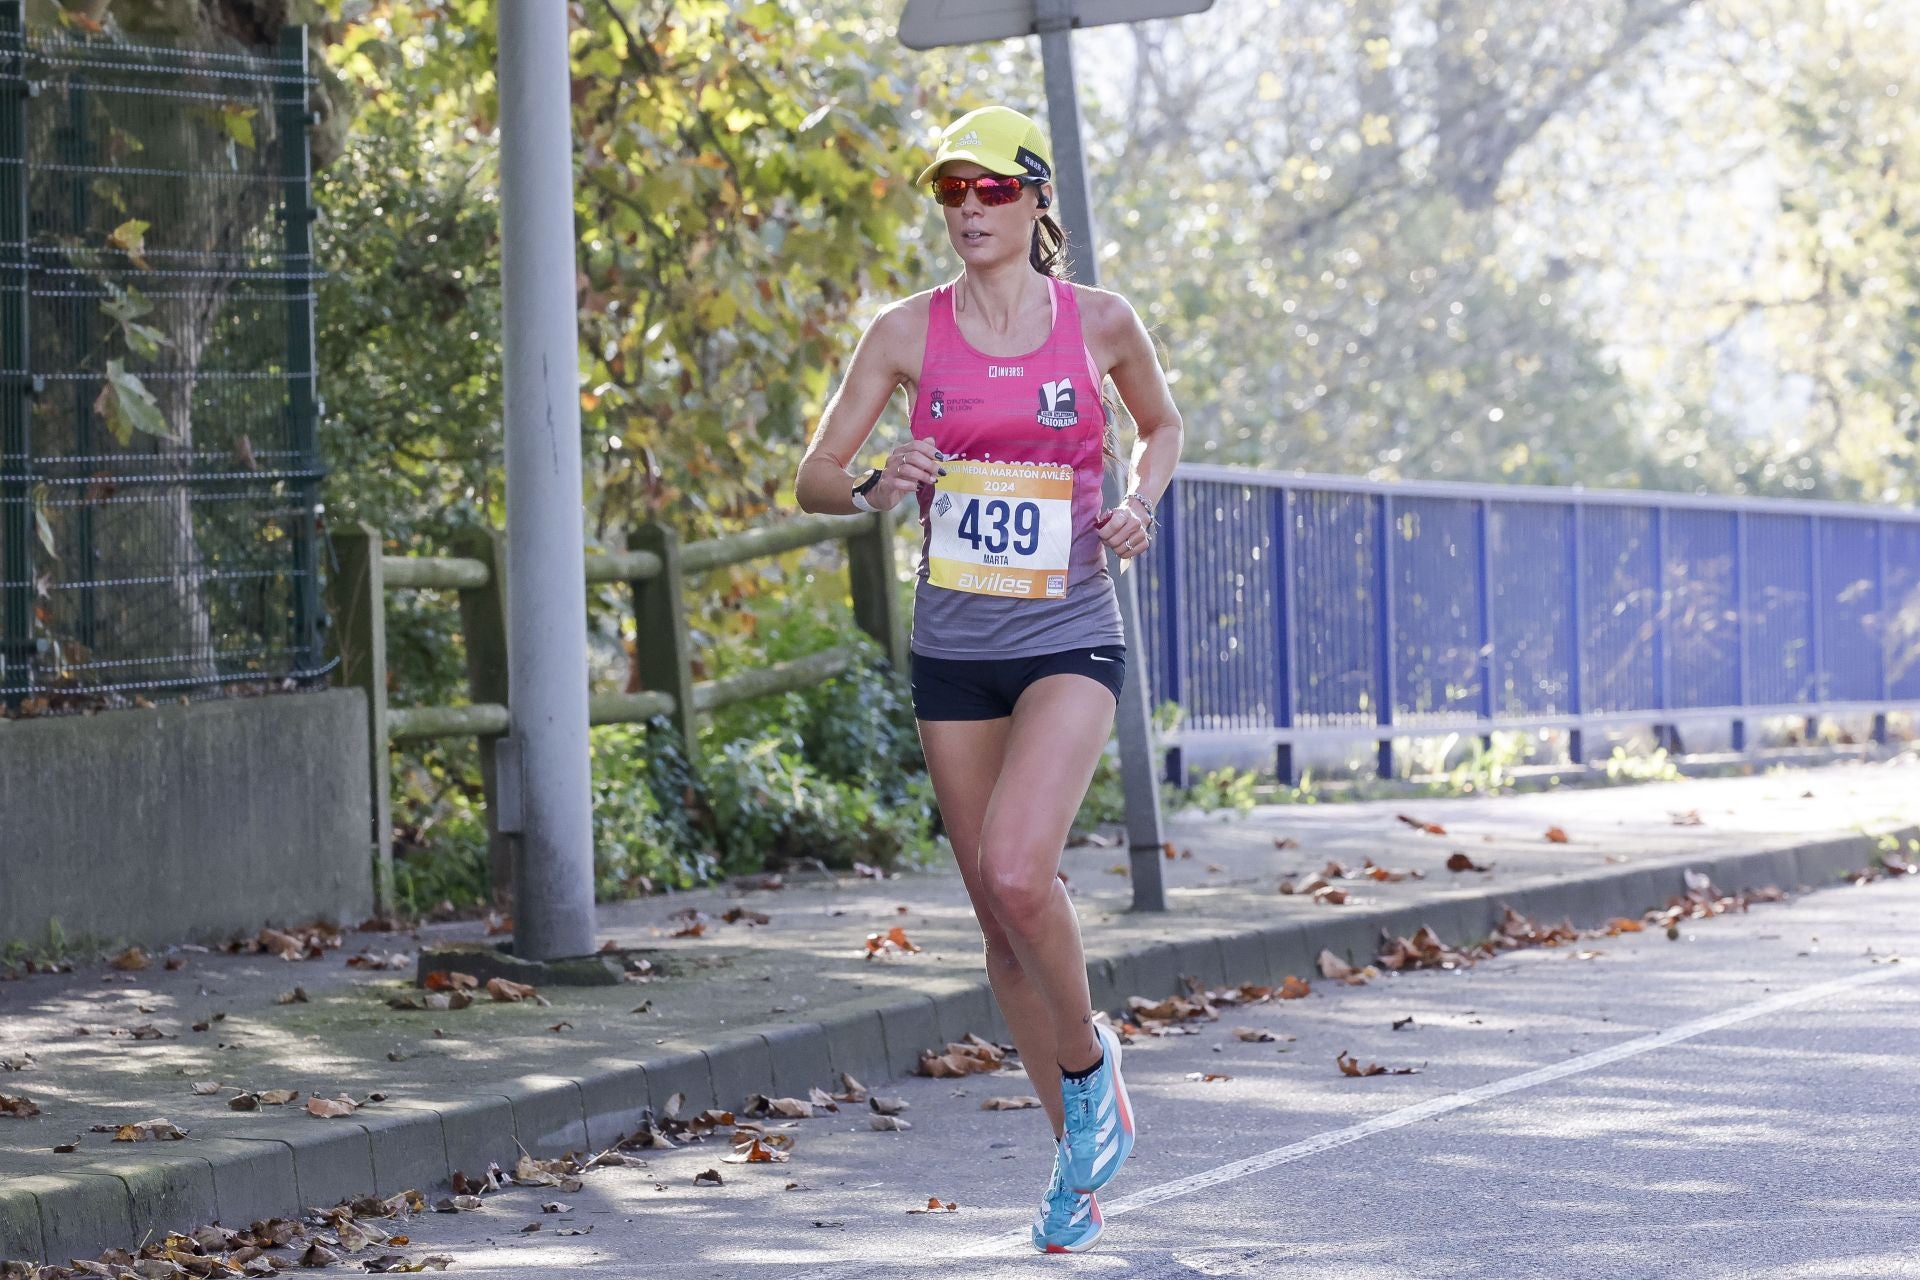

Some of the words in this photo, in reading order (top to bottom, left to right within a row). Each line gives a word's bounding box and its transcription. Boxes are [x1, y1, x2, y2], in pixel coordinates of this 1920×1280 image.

[1037, 414, 1078, 427] FISIORAMA
[963, 464, 987, 476] MEDIA
[990, 466, 1039, 479] MARATÓN
[1041, 469, 1071, 481] AVILÉS
[984, 481, 1016, 492] 2024
[958, 498, 1040, 556] 439
[983, 554, 1009, 566] MARTA
[959, 573, 1032, 593] avilés
